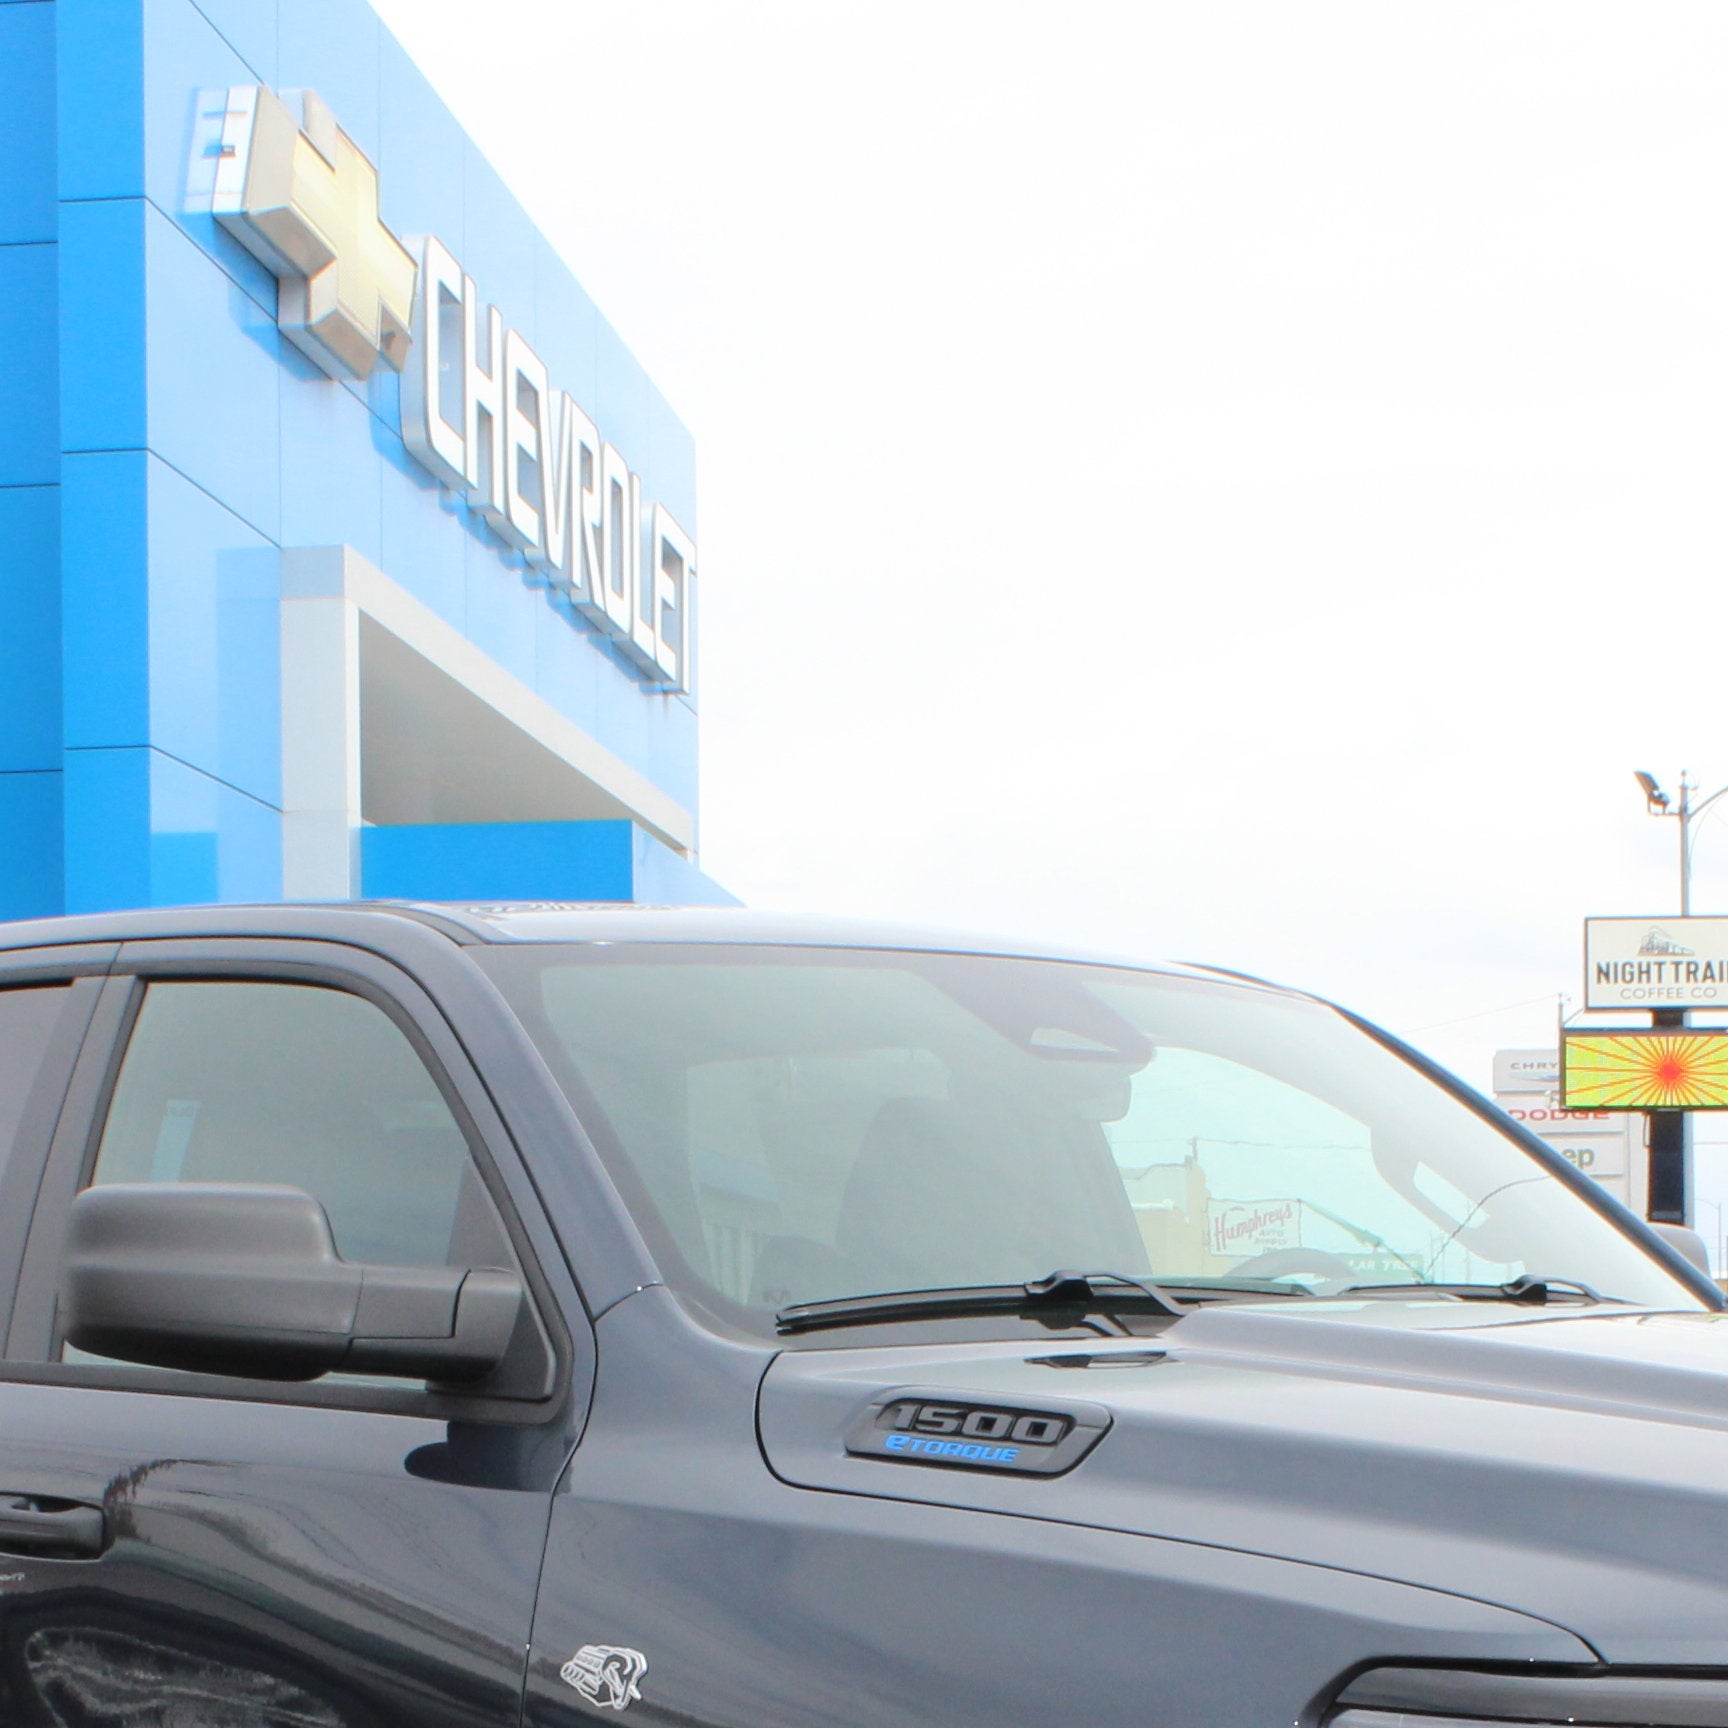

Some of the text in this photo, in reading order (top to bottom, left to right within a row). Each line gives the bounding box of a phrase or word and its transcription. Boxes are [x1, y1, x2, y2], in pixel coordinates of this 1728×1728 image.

[399, 235, 698, 696] CHEVROLET
[1596, 960, 1666, 984] NIGHT
[1619, 986, 1717, 1000] COFFEE CO
[1510, 1062, 1559, 1071] CHRY
[1561, 1147, 1595, 1169] ep
[892, 1402, 1069, 1444] 1500
